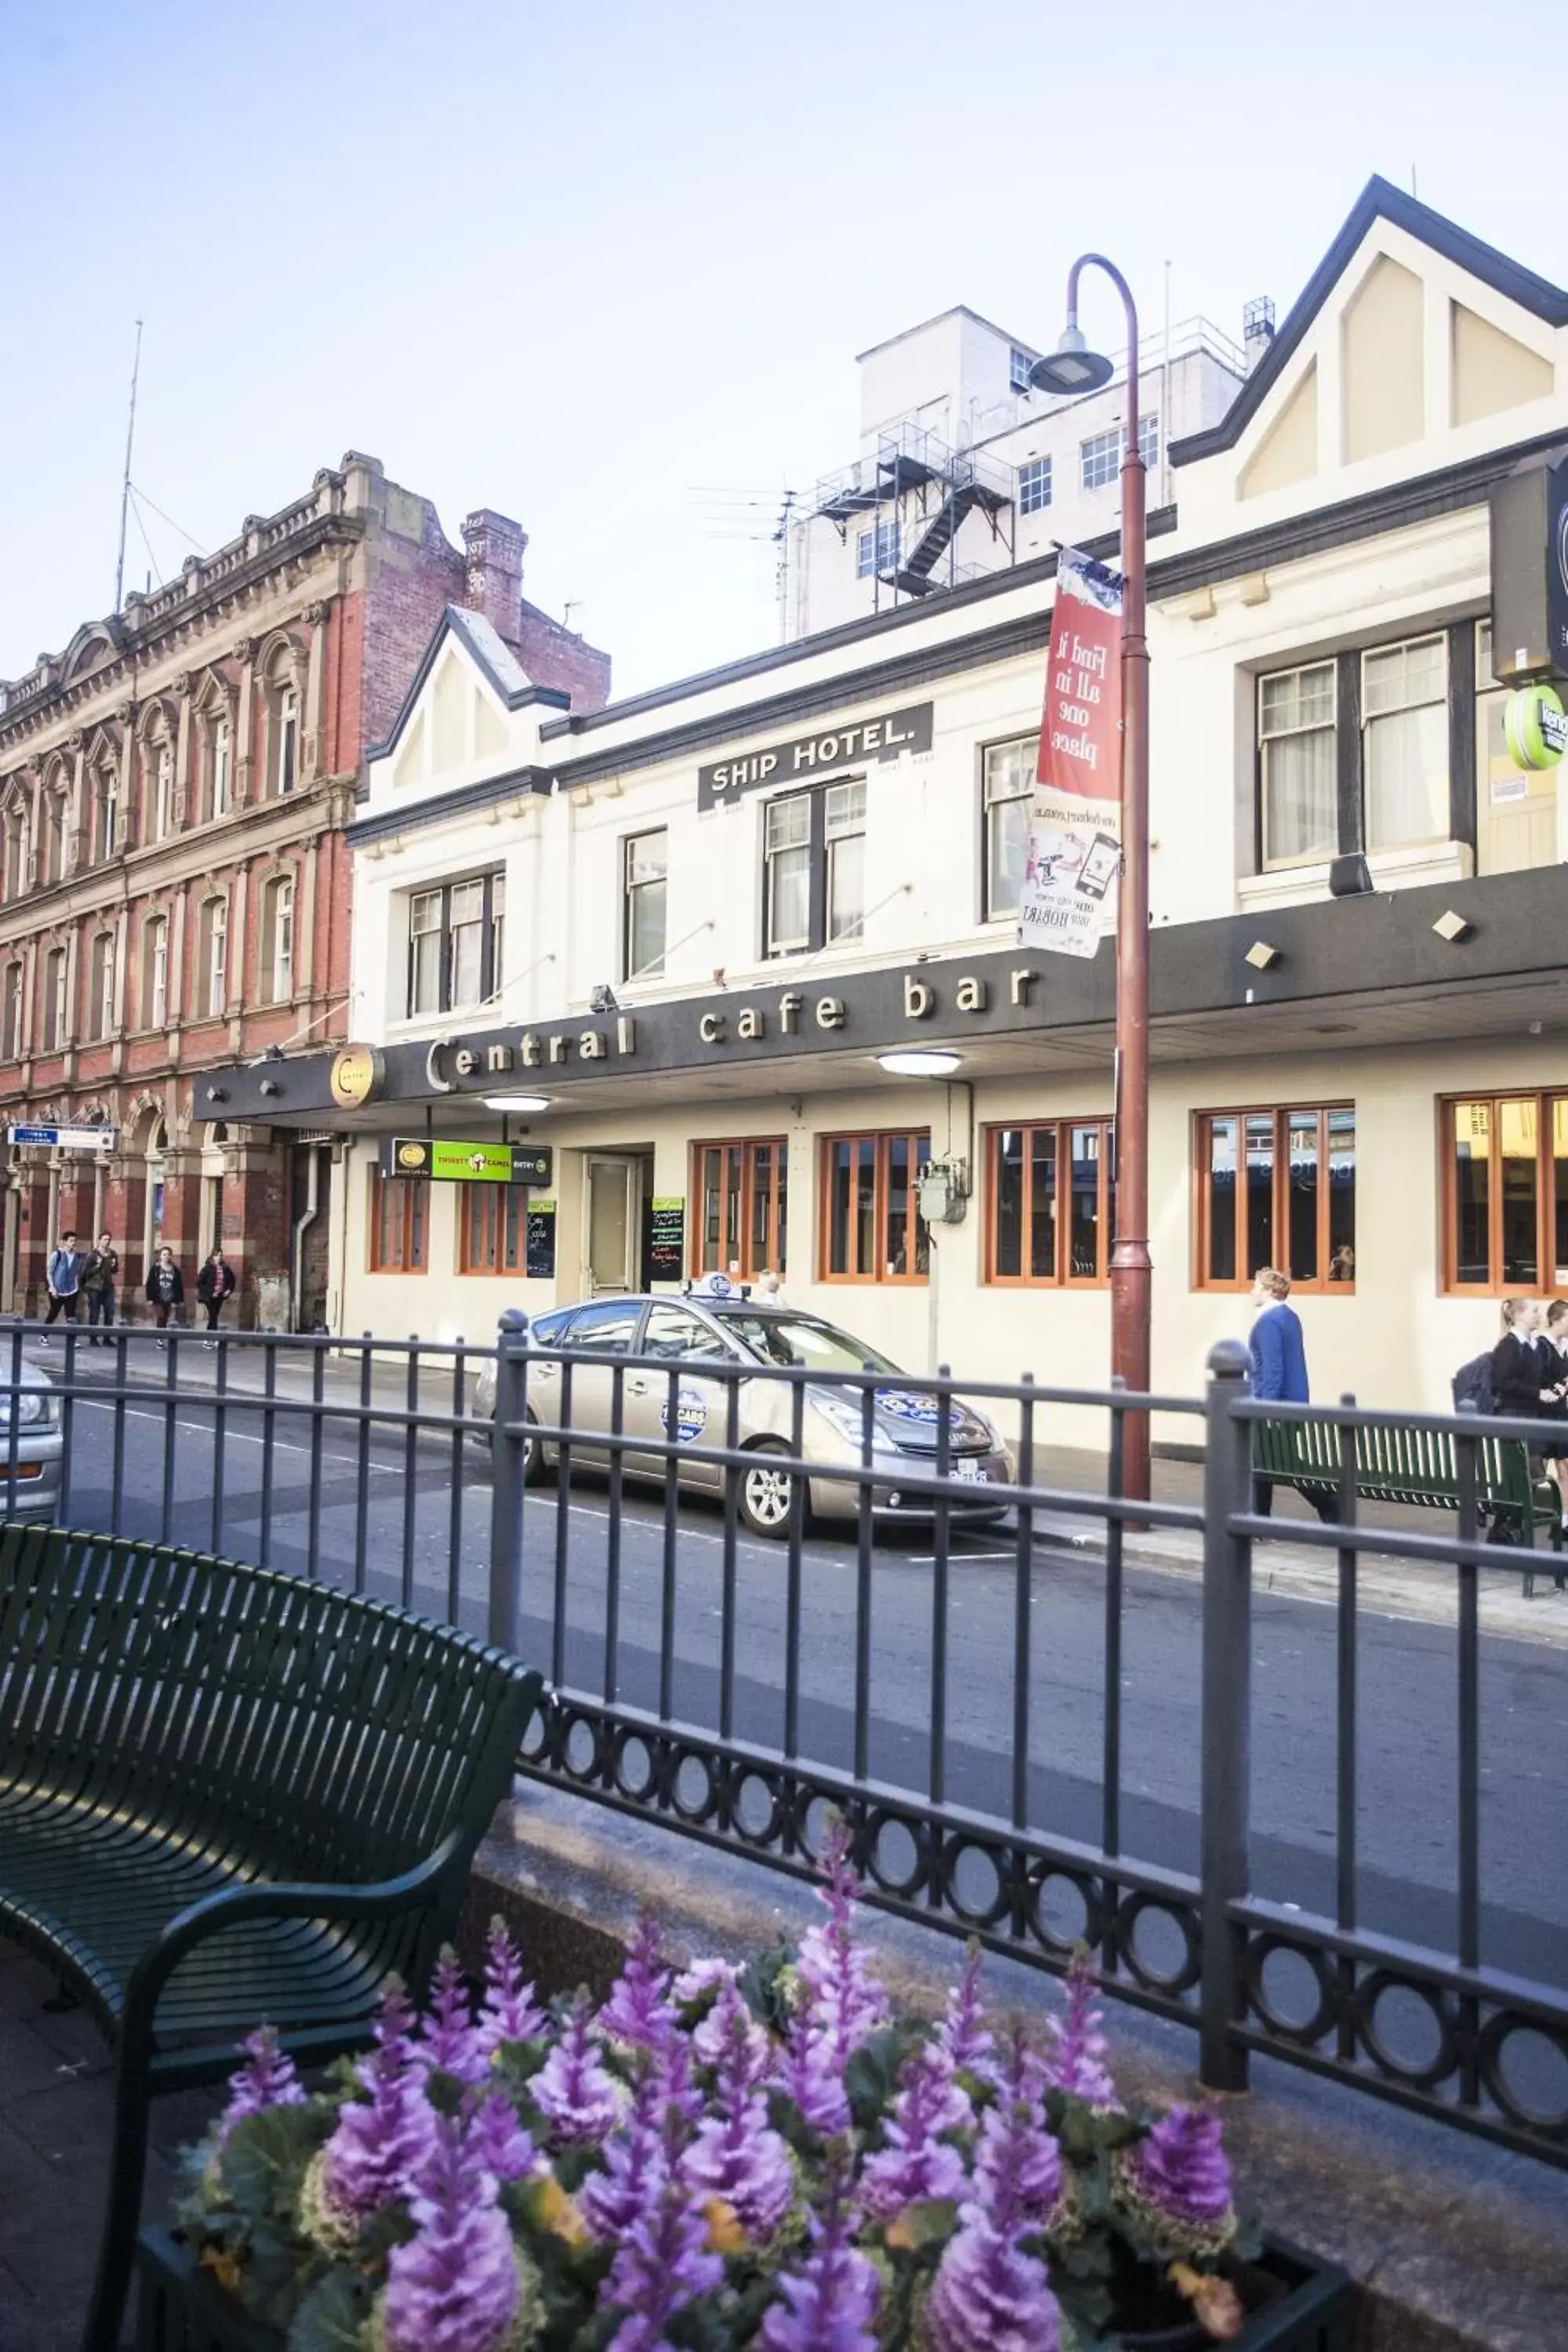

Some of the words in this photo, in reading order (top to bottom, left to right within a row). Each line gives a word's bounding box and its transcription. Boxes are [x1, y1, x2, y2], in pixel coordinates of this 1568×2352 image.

[711, 753, 778, 791] SHIP
[426, 1017, 635, 1092] Central
[699, 992, 845, 1043] cafe
[904, 967, 1038, 1019] bar
[514, 1160, 534, 1171] ENTRY
